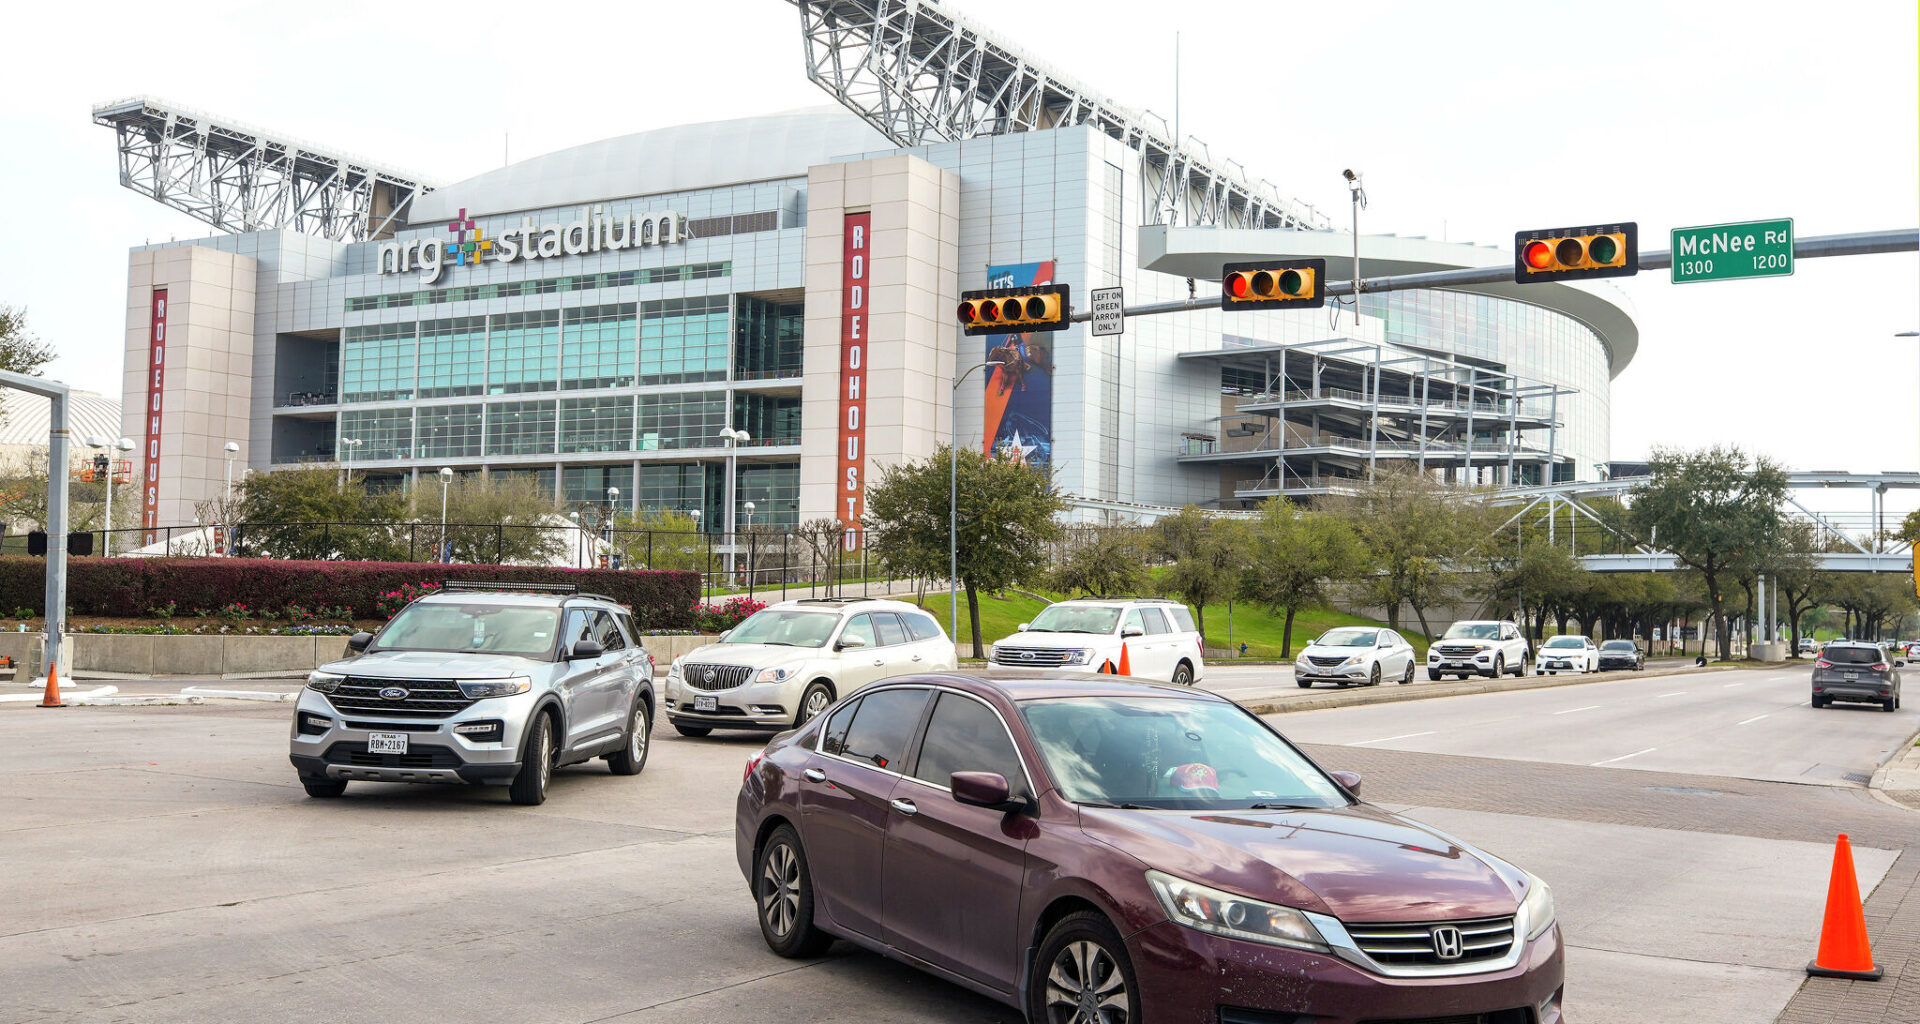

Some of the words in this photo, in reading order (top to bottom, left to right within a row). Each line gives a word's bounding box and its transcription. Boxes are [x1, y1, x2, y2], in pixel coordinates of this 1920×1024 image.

[377, 237, 444, 284] nrg
[497, 205, 681, 263] stadium
[1680, 232, 1755, 256] McNee
[1764, 229, 1787, 244] Rd
[1680, 259, 1713, 275] 1300
[1753, 253, 1787, 269] 1200
[1093, 293, 1109, 301] LEFT
[1096, 303, 1119, 311] GREEN
[1095, 312, 1120, 321] ARROW
[1098, 322, 1117, 331] ONLY
